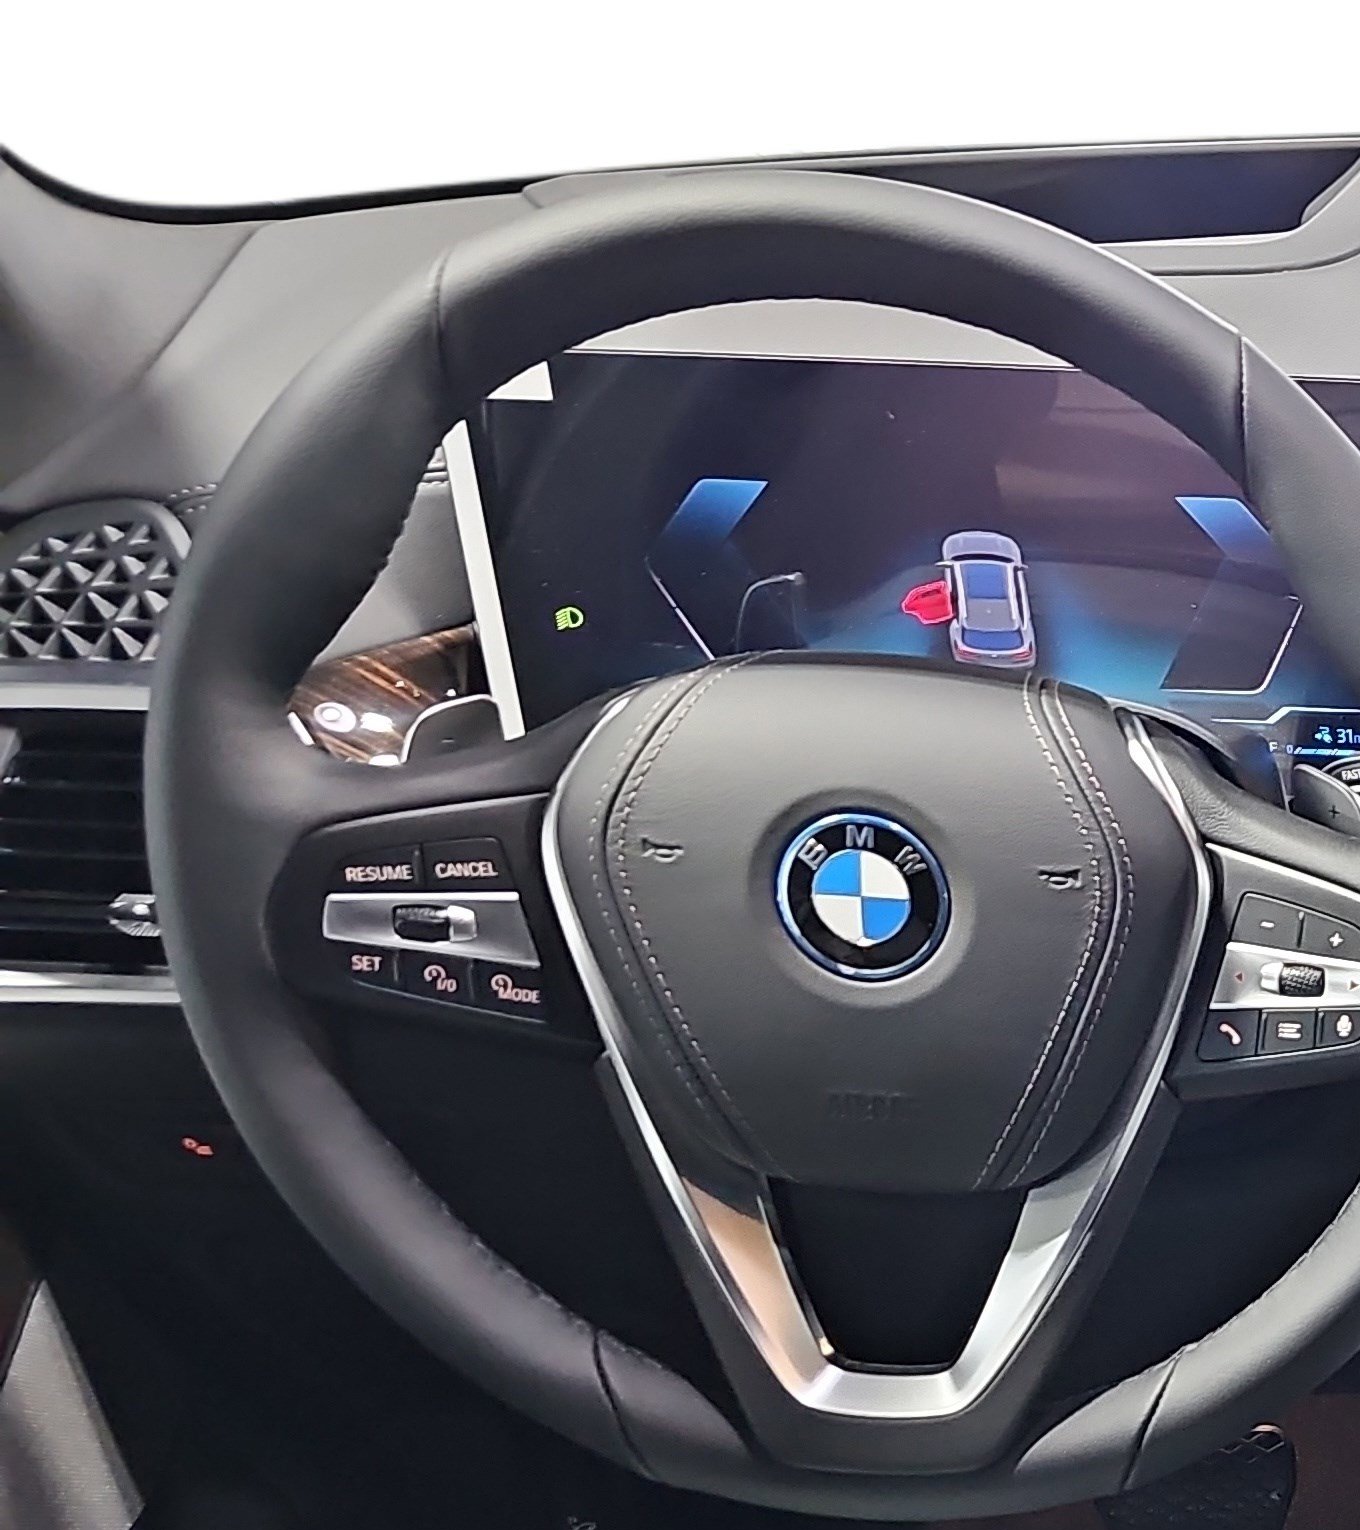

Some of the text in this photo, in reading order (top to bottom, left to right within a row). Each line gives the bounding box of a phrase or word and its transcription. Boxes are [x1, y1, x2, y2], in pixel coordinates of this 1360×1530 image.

[797, 824, 927, 876] BMW
[344, 863, 414, 883] RESUME
[435, 861, 499, 879] CANCEL
[351, 954, 383, 972] SET
[498, 987, 541, 1004] MODE
